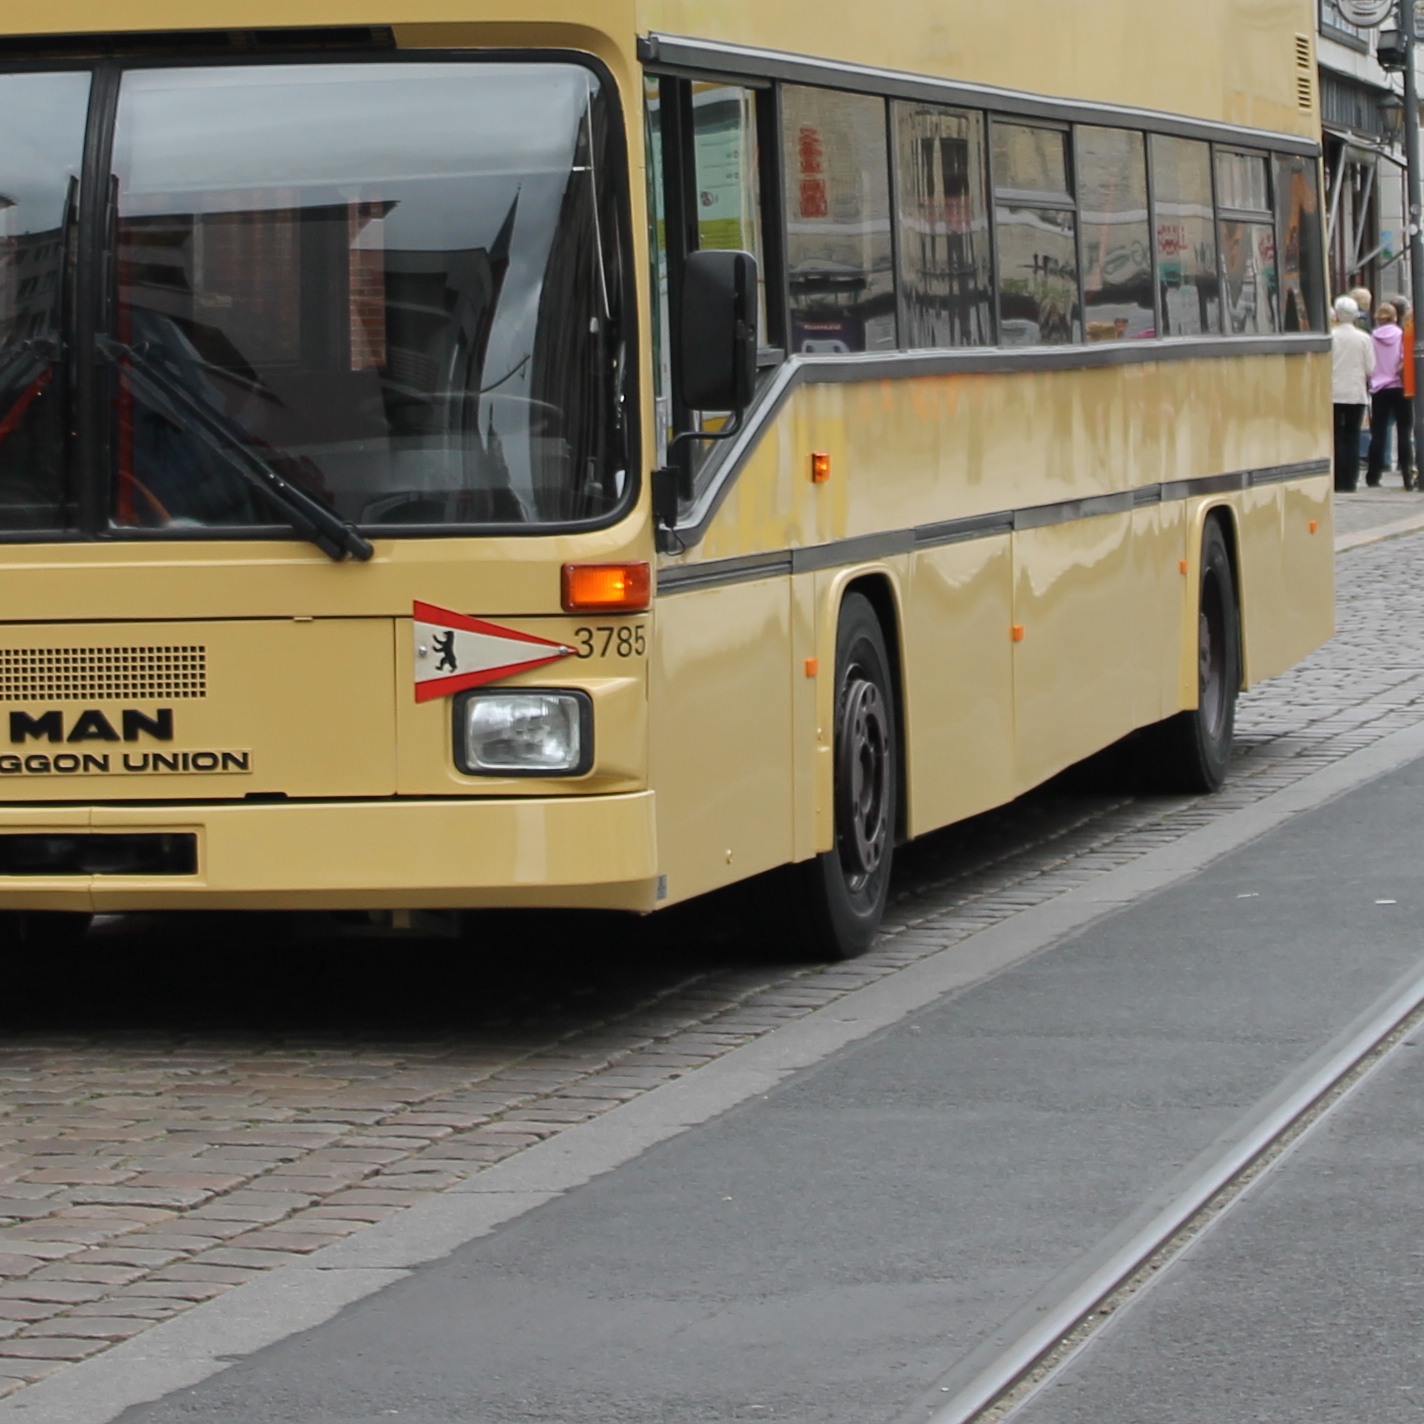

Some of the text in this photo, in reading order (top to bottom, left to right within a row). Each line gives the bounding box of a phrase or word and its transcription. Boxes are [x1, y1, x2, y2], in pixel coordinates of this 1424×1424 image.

[574, 624, 646, 659] 3785
[9, 708, 174, 743] MAN
[122, 751, 250, 772] UNION
